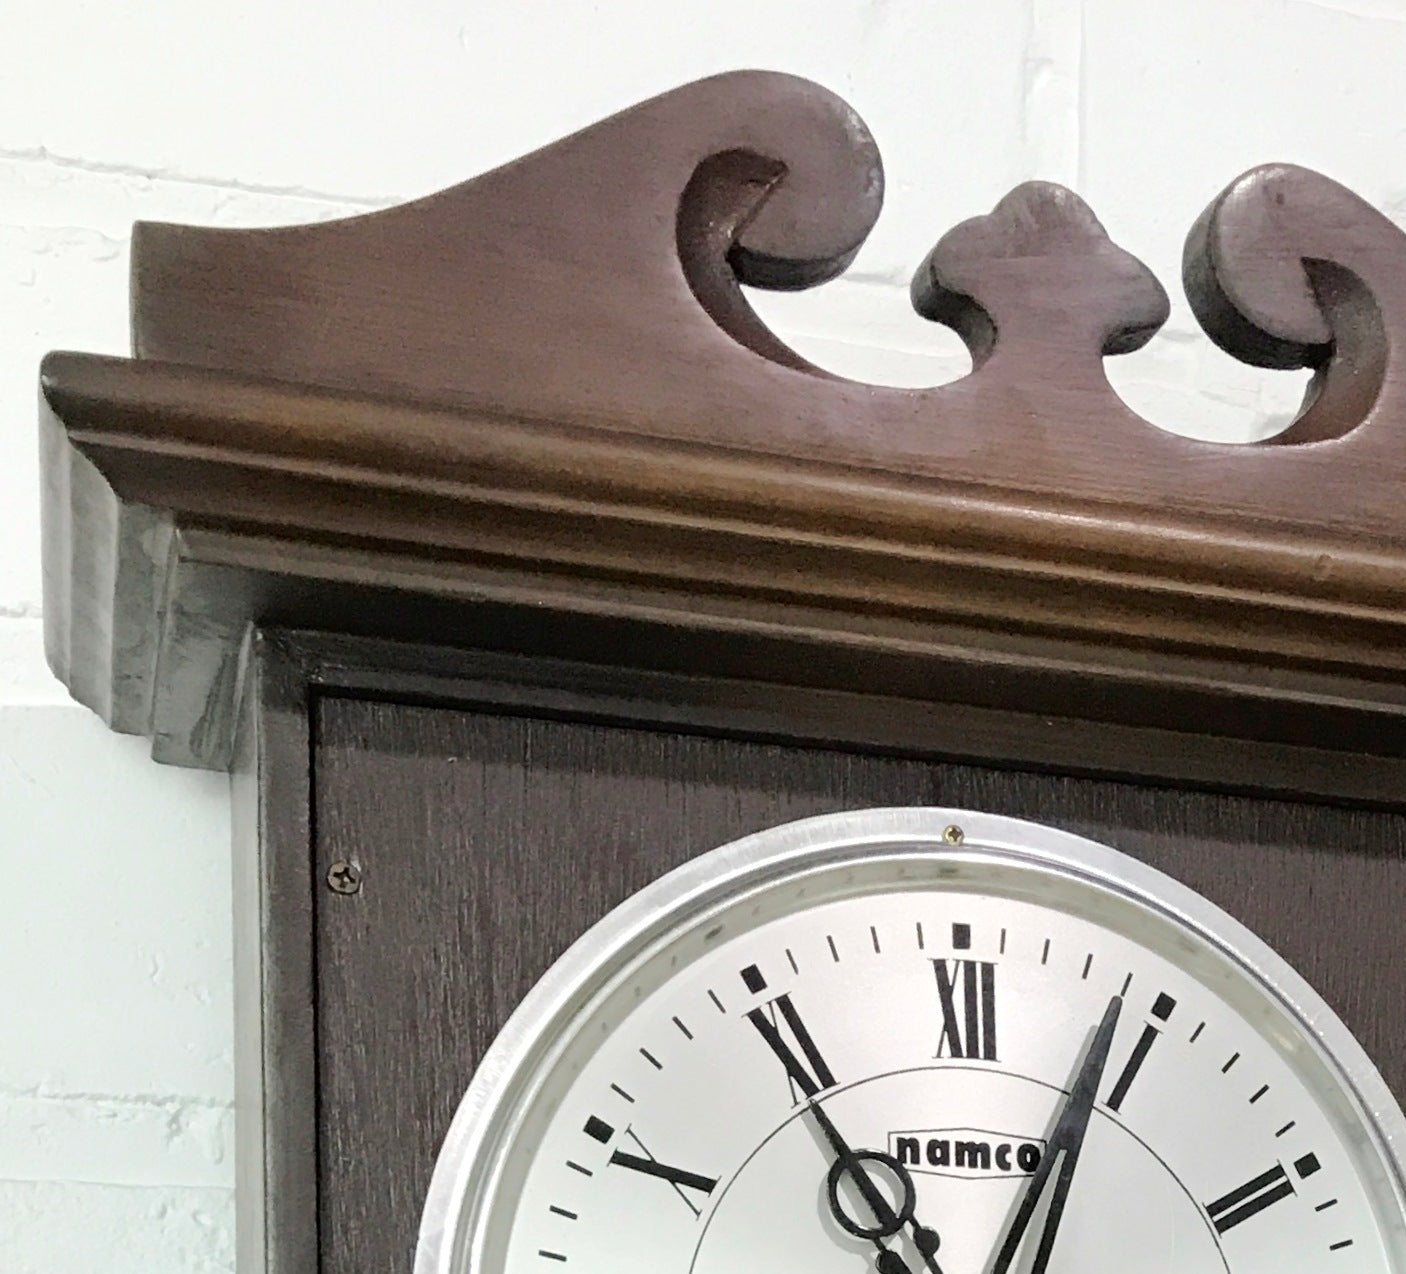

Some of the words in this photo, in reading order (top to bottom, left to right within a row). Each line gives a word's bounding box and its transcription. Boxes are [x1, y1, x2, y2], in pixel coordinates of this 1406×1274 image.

[746, 995, 839, 1105] XI
[931, 958, 1000, 1061] XII
[1105, 1022, 1159, 1113] I
[608, 1125, 722, 1218] X
[896, 1137, 1041, 1173] namco
[1203, 1160, 1296, 1237] II
